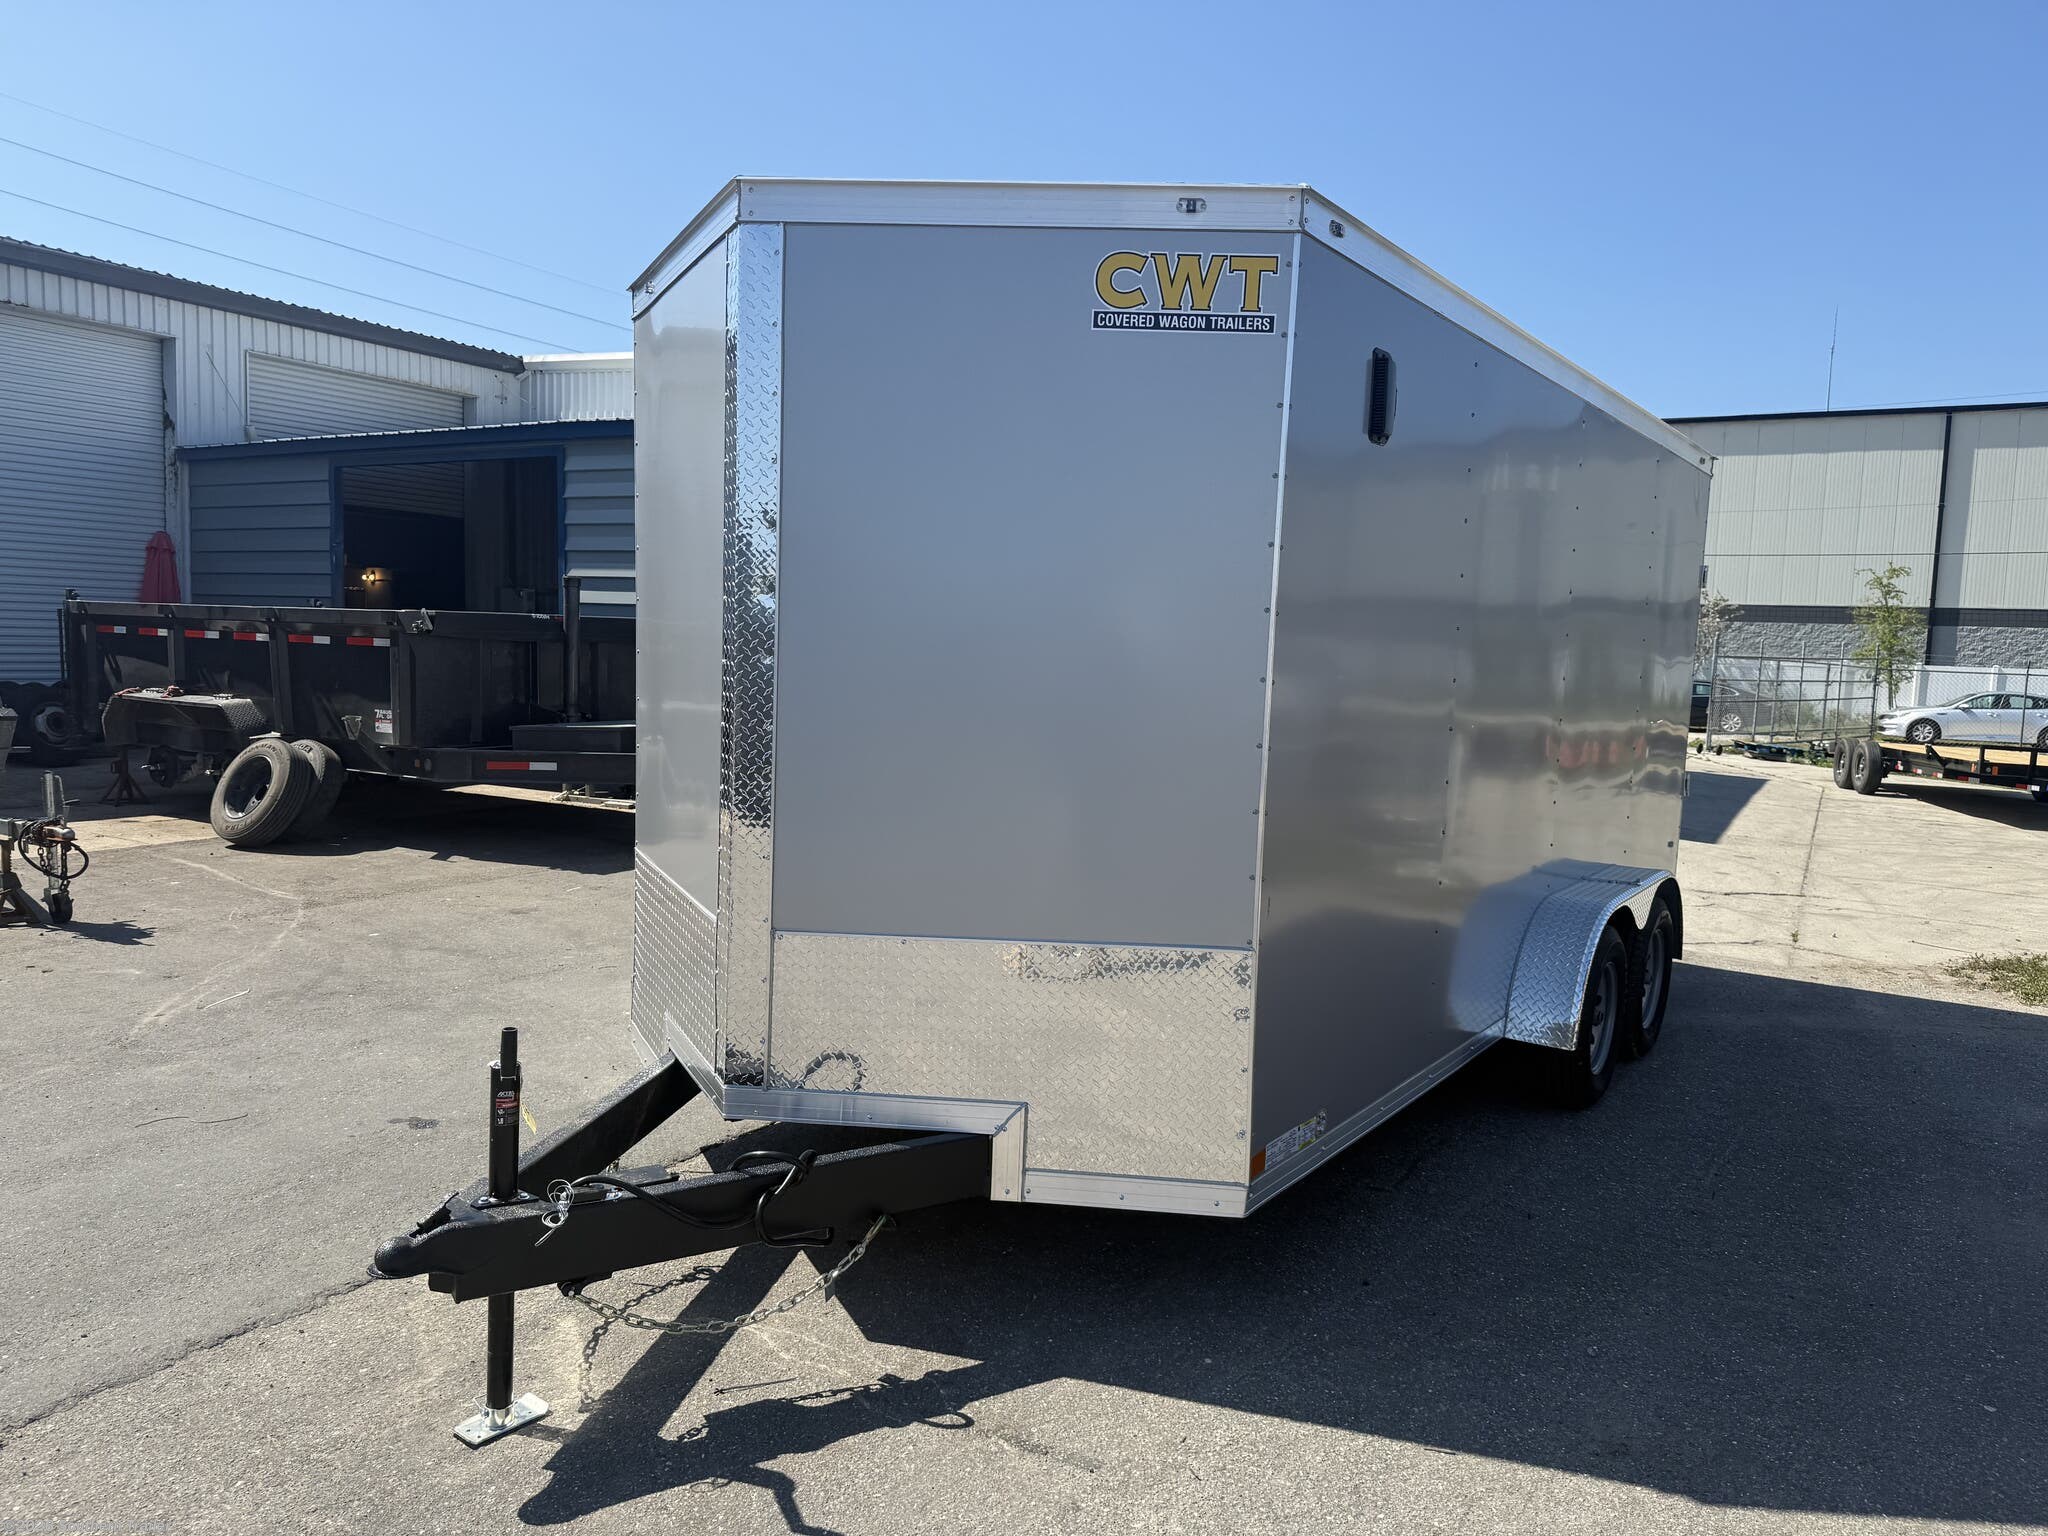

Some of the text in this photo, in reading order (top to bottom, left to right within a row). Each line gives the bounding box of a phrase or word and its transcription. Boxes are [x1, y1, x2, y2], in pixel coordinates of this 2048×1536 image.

[1095, 250, 1279, 312] CWT
[1097, 313, 1271, 331] COVERED WAGON TRAILERS
